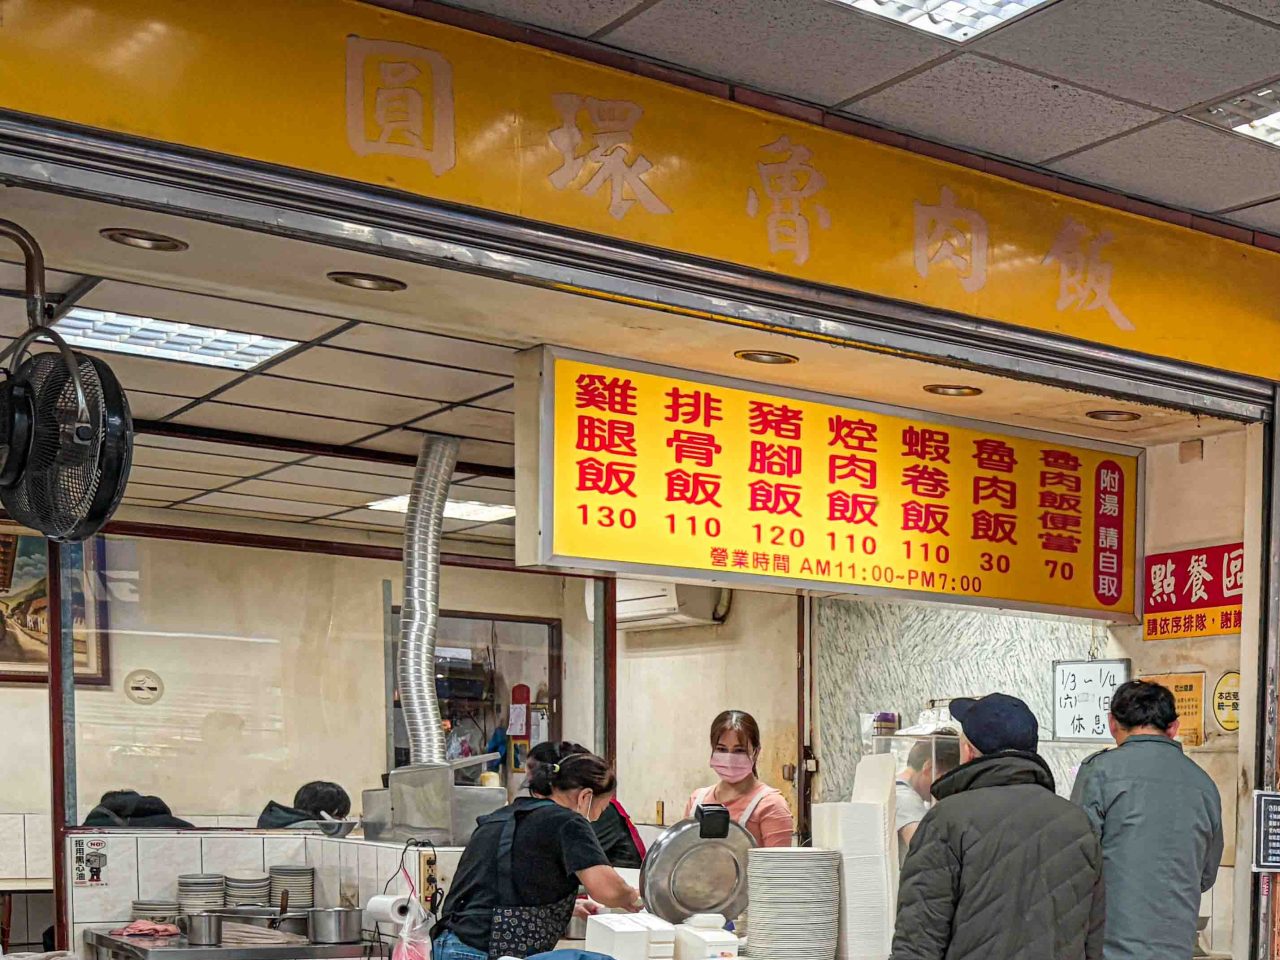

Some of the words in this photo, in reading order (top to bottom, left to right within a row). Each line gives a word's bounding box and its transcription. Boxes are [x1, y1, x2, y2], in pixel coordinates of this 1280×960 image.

[346, 34, 1136, 332] 圓環魯肉飯
[575, 374, 638, 498] 雞腿飯
[664, 387, 723, 508] 排骨飯
[748, 400, 804, 518] 豬腳飯
[827, 415, 878, 527] 焢肉飯
[901, 425, 950, 537] 蝦卷飯
[971, 438, 1018, 546] 魯肉飯
[1099, 468, 1120, 518] 附湯
[577, 504, 637, 529] 130
[665, 513, 721, 538] 110
[1037, 450, 1082, 554] 魯肉飯便當
[710, 546, 790, 574] 營業時間
[751, 523, 805, 548] 120
[826, 531, 877, 555] 110
[902, 540, 949, 564] 110
[980, 552, 1010, 573] 30
[1045, 559, 1074, 580] 70
[1098, 526, 1119, 598] 請自取
[1149, 549, 1243, 606] 點餐區
[1061, 669, 1077, 691] 1/3
[1071, 714, 1107, 736] 休息
